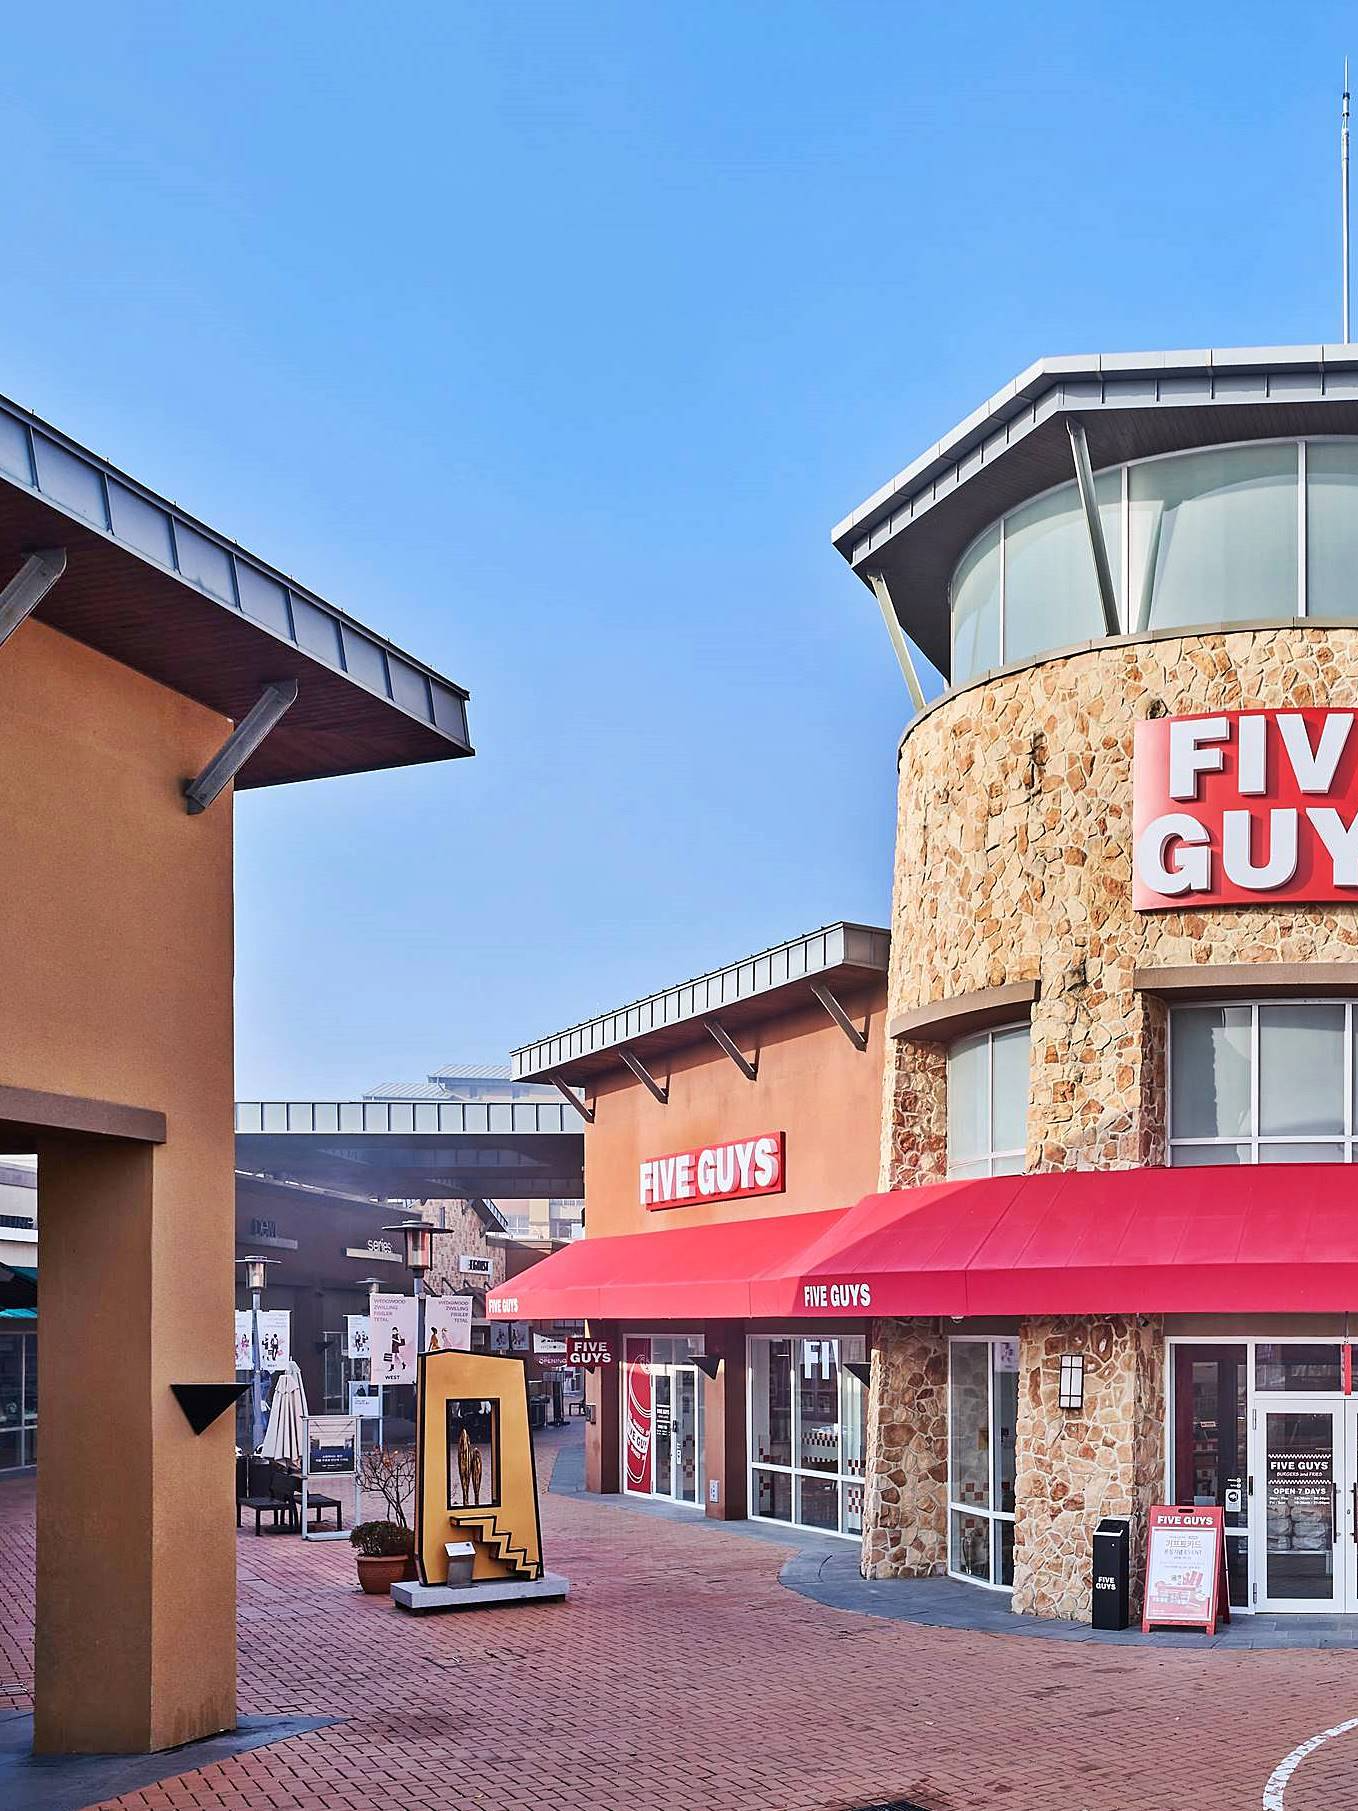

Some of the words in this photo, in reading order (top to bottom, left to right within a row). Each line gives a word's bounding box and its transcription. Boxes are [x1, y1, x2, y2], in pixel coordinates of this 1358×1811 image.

[640, 1154, 696, 1205] FIVE
[697, 1138, 778, 1196] GUYS
[367, 1238, 392, 1254] series
[804, 1285, 828, 1307] FIVE
[830, 1283, 871, 1307] GUYS
[488, 1298, 502, 1313] FIVE
[502, 1298, 519, 1313] GUYS
[574, 1342, 608, 1352] FIVE
[570, 1352, 612, 1363] GUYS
[1270, 1461, 1295, 1470] FIVE
[1298, 1461, 1329, 1470] GUYS
[1157, 1515, 1181, 1525] FIVE
[1183, 1516, 1213, 1525] GUYS
[1095, 1583, 1117, 1591] GUYS
